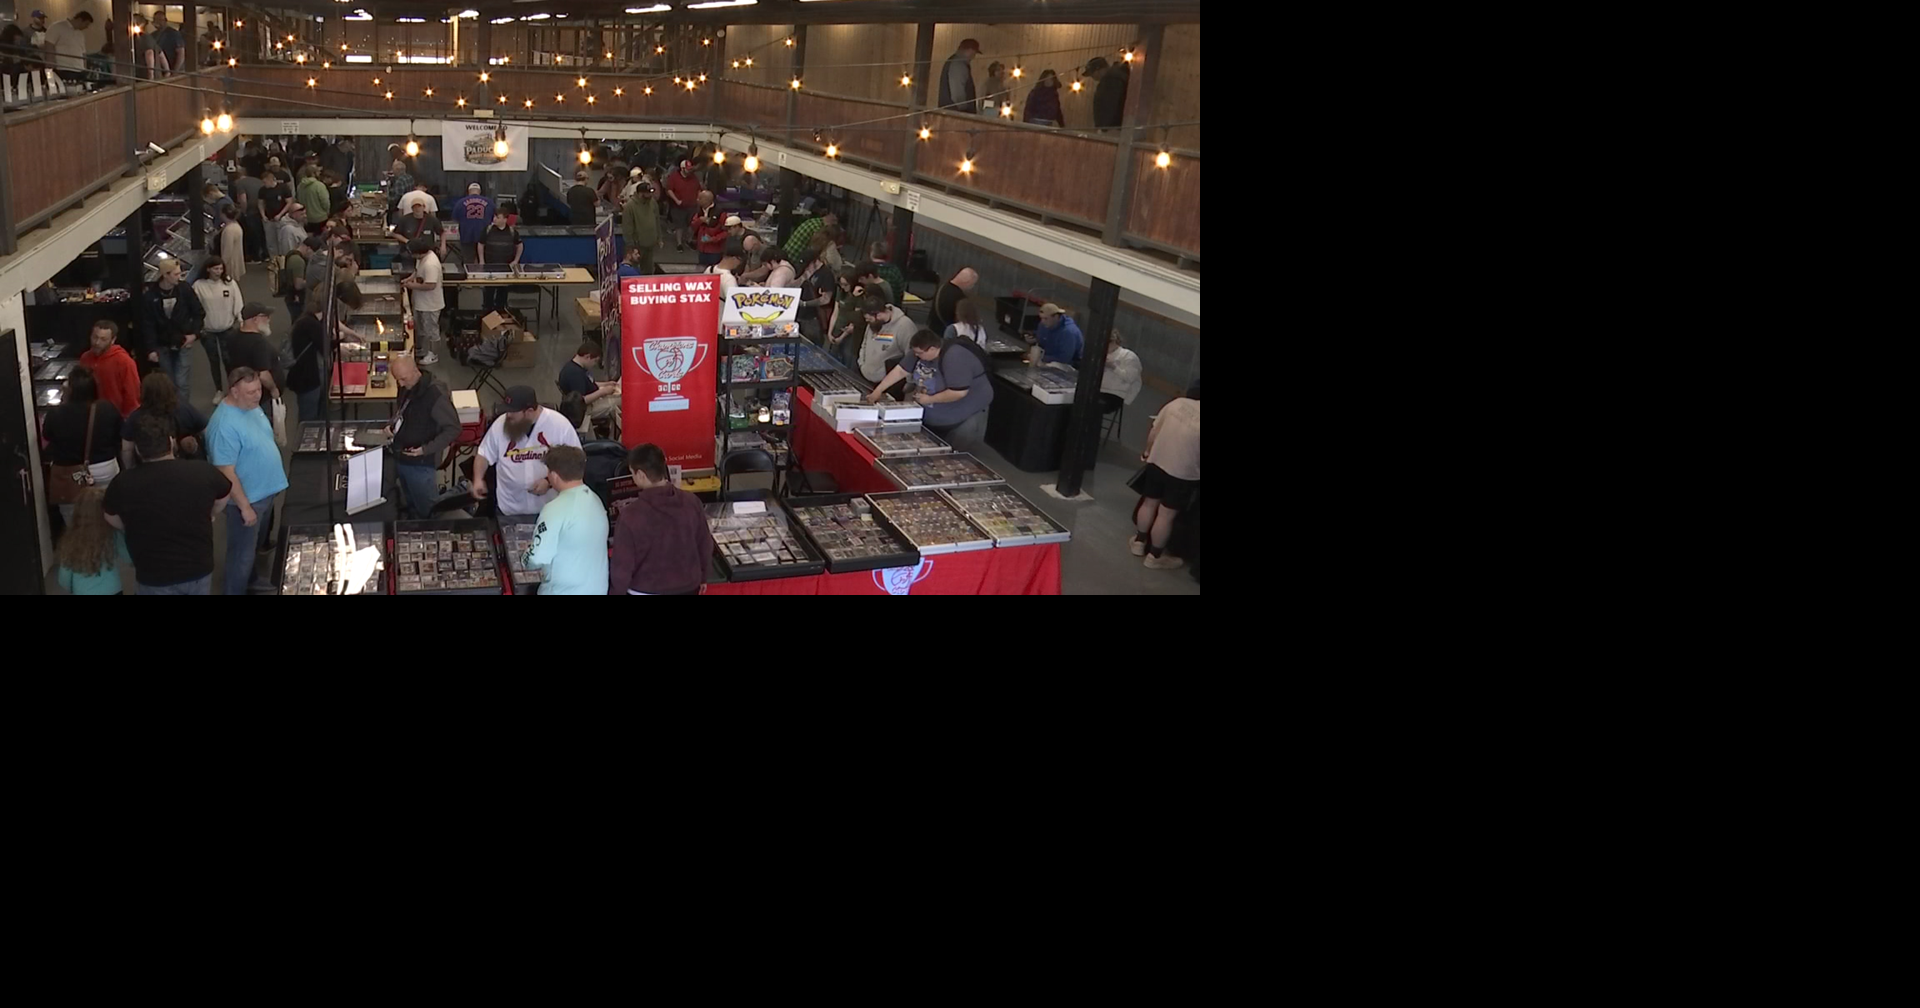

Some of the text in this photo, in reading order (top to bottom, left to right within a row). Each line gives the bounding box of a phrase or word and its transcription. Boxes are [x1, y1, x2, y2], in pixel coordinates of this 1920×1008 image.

[466, 204, 485, 219] 23
[628, 281, 713, 294] SELLING WAX
[630, 293, 711, 305] BUYING STAX
[511, 448, 548, 463] Cardinal
